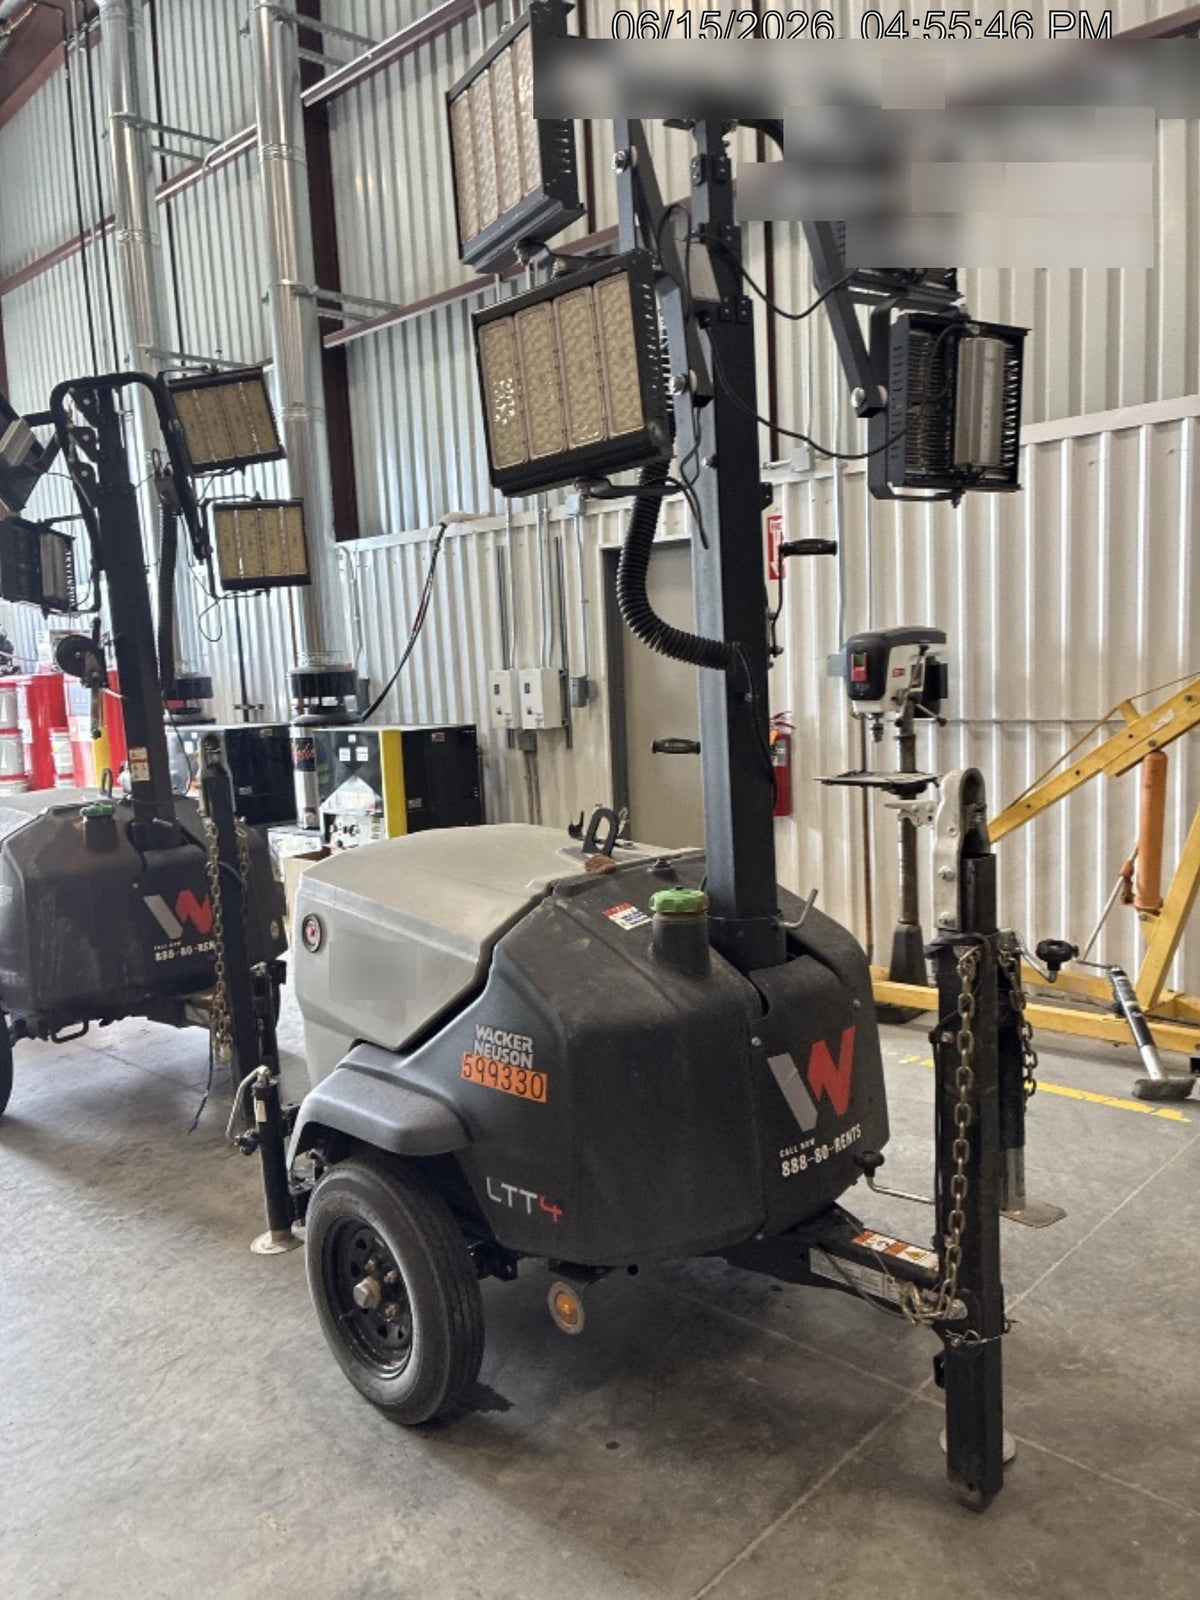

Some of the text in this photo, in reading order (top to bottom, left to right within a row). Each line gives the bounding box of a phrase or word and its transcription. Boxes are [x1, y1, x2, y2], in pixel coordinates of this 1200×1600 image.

[474, 1039, 534, 1069] NEUSON
[475, 1024, 534, 1053] WACKER
[462, 1053, 546, 1100] 599330
[781, 1123, 862, 1178] 888-80-RENTS
[486, 1175, 563, 1223] LTT4
